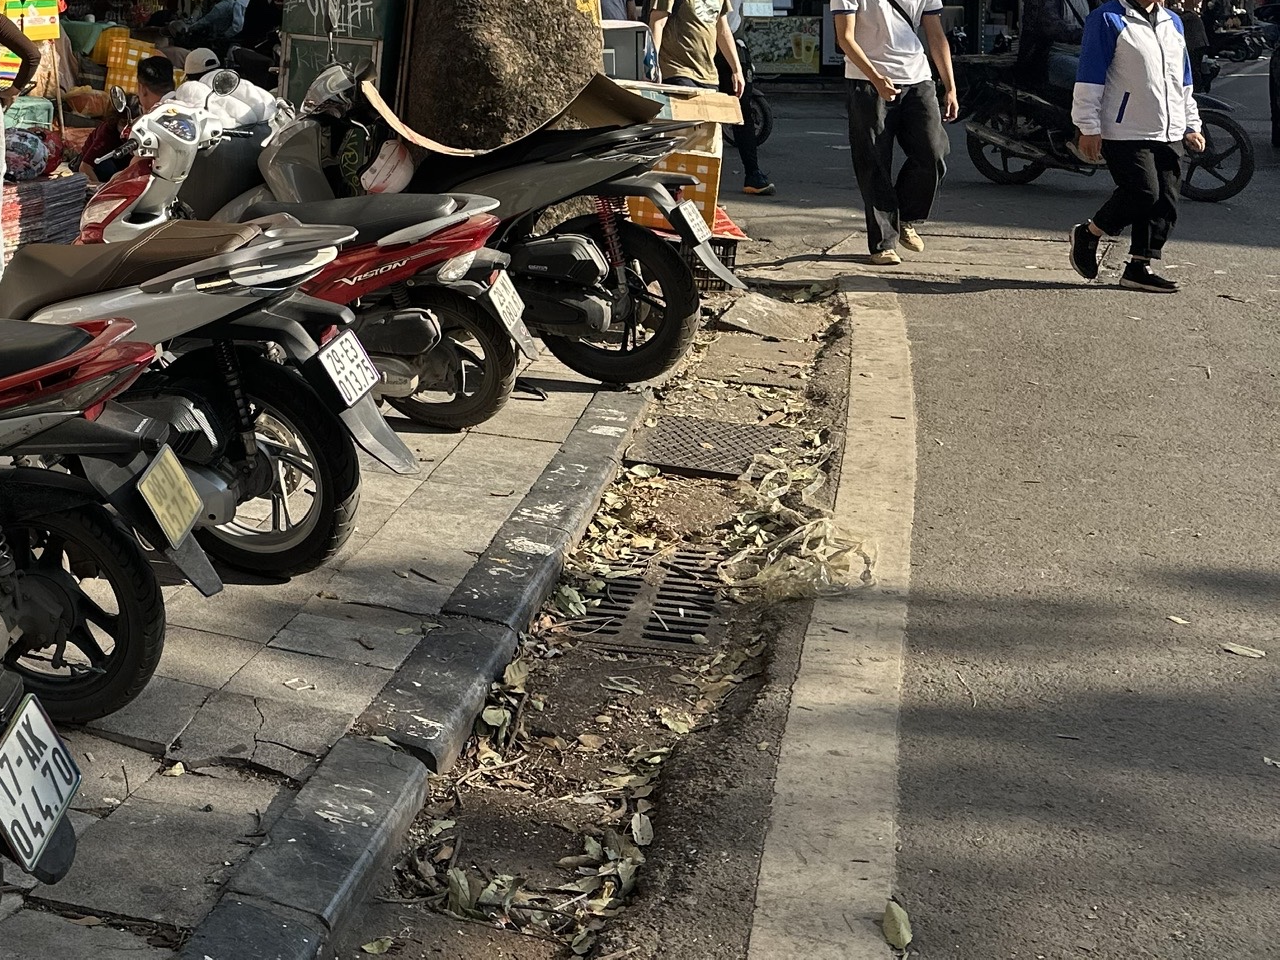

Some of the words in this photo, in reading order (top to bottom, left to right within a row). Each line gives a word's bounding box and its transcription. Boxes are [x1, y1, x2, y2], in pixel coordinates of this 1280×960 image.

[326, 337, 359, 376] 29-E3
[338, 358, 375, 403] 013.75
[11, 747, 74, 860] 044.70
